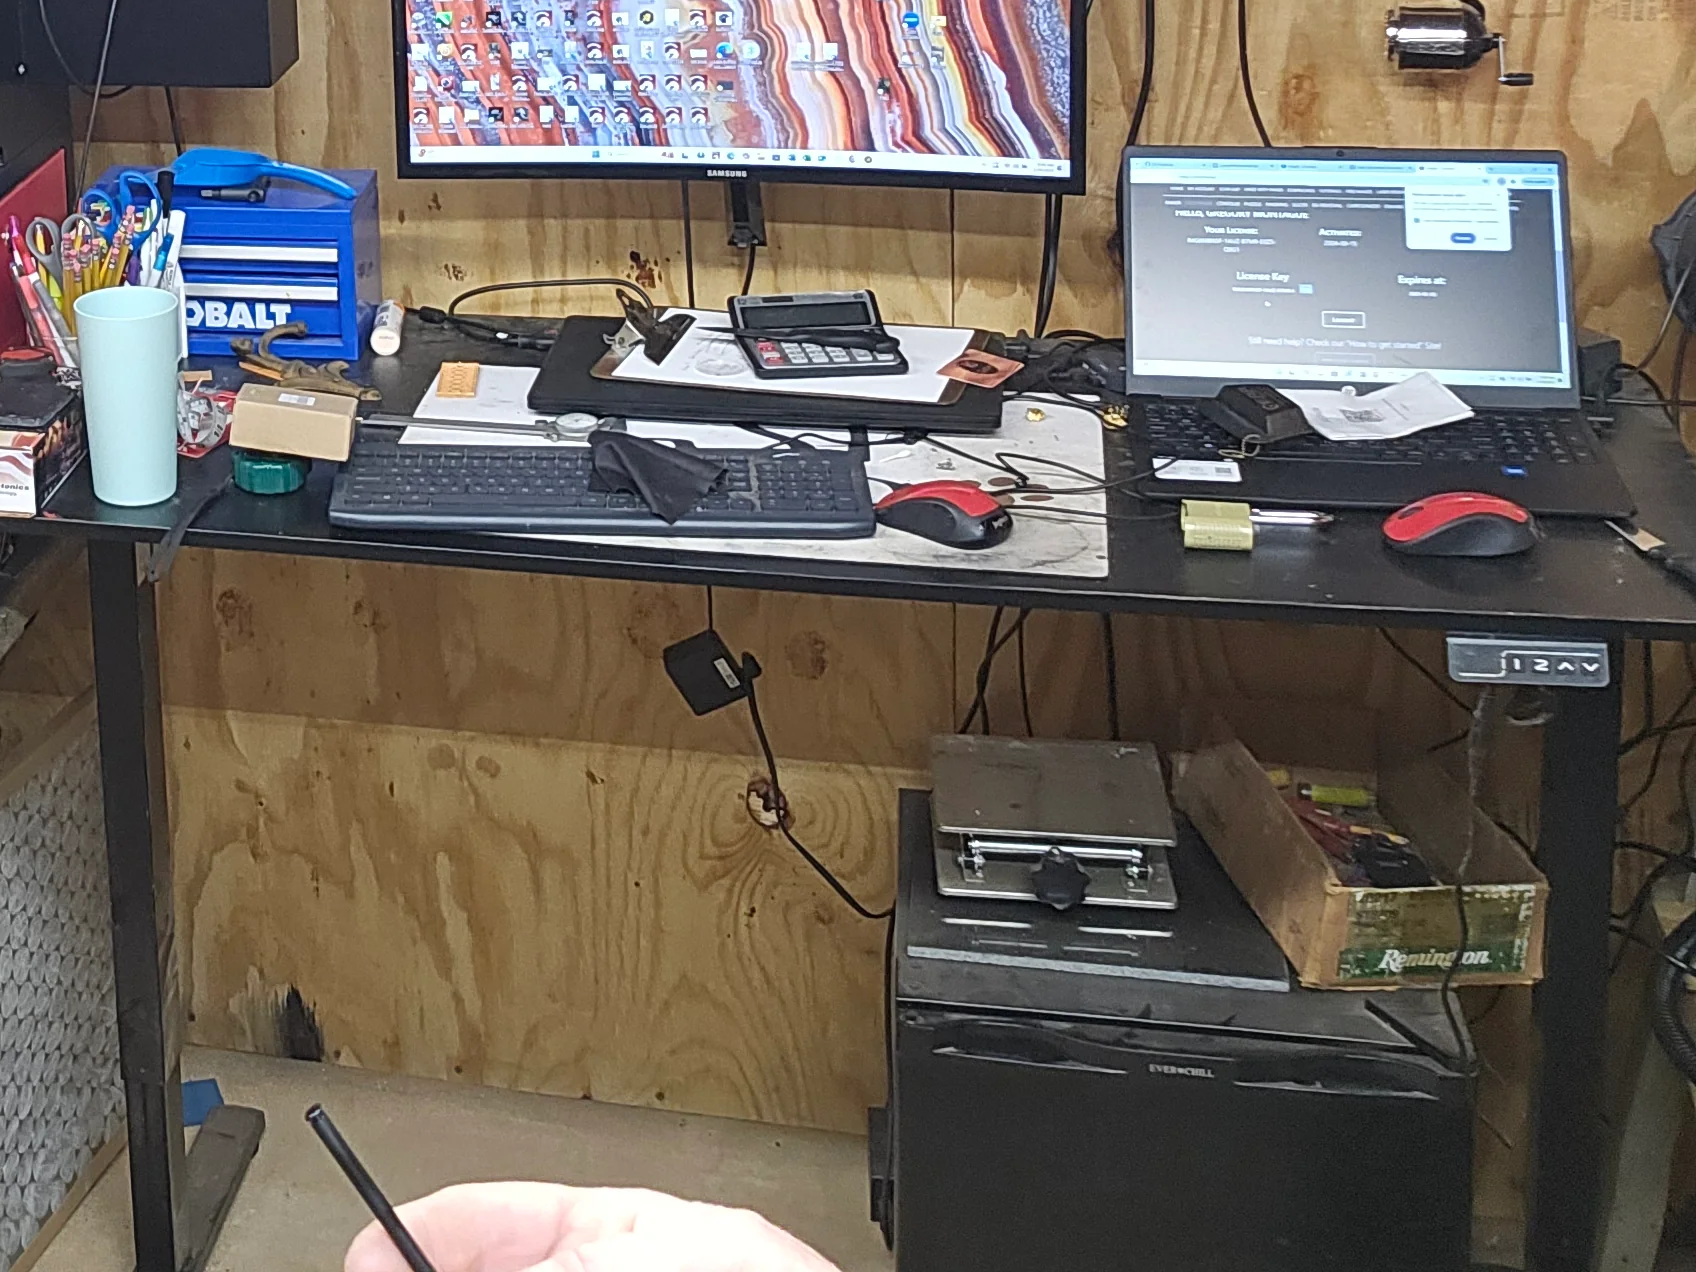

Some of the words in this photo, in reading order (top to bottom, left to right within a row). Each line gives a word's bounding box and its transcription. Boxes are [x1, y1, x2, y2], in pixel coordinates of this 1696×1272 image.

[706, 169, 748, 178] SAMSUNG
[186, 300, 292, 329] OBALT
[1532, 658, 1549, 672] 2
[1378, 948, 1492, 973] Remingon
